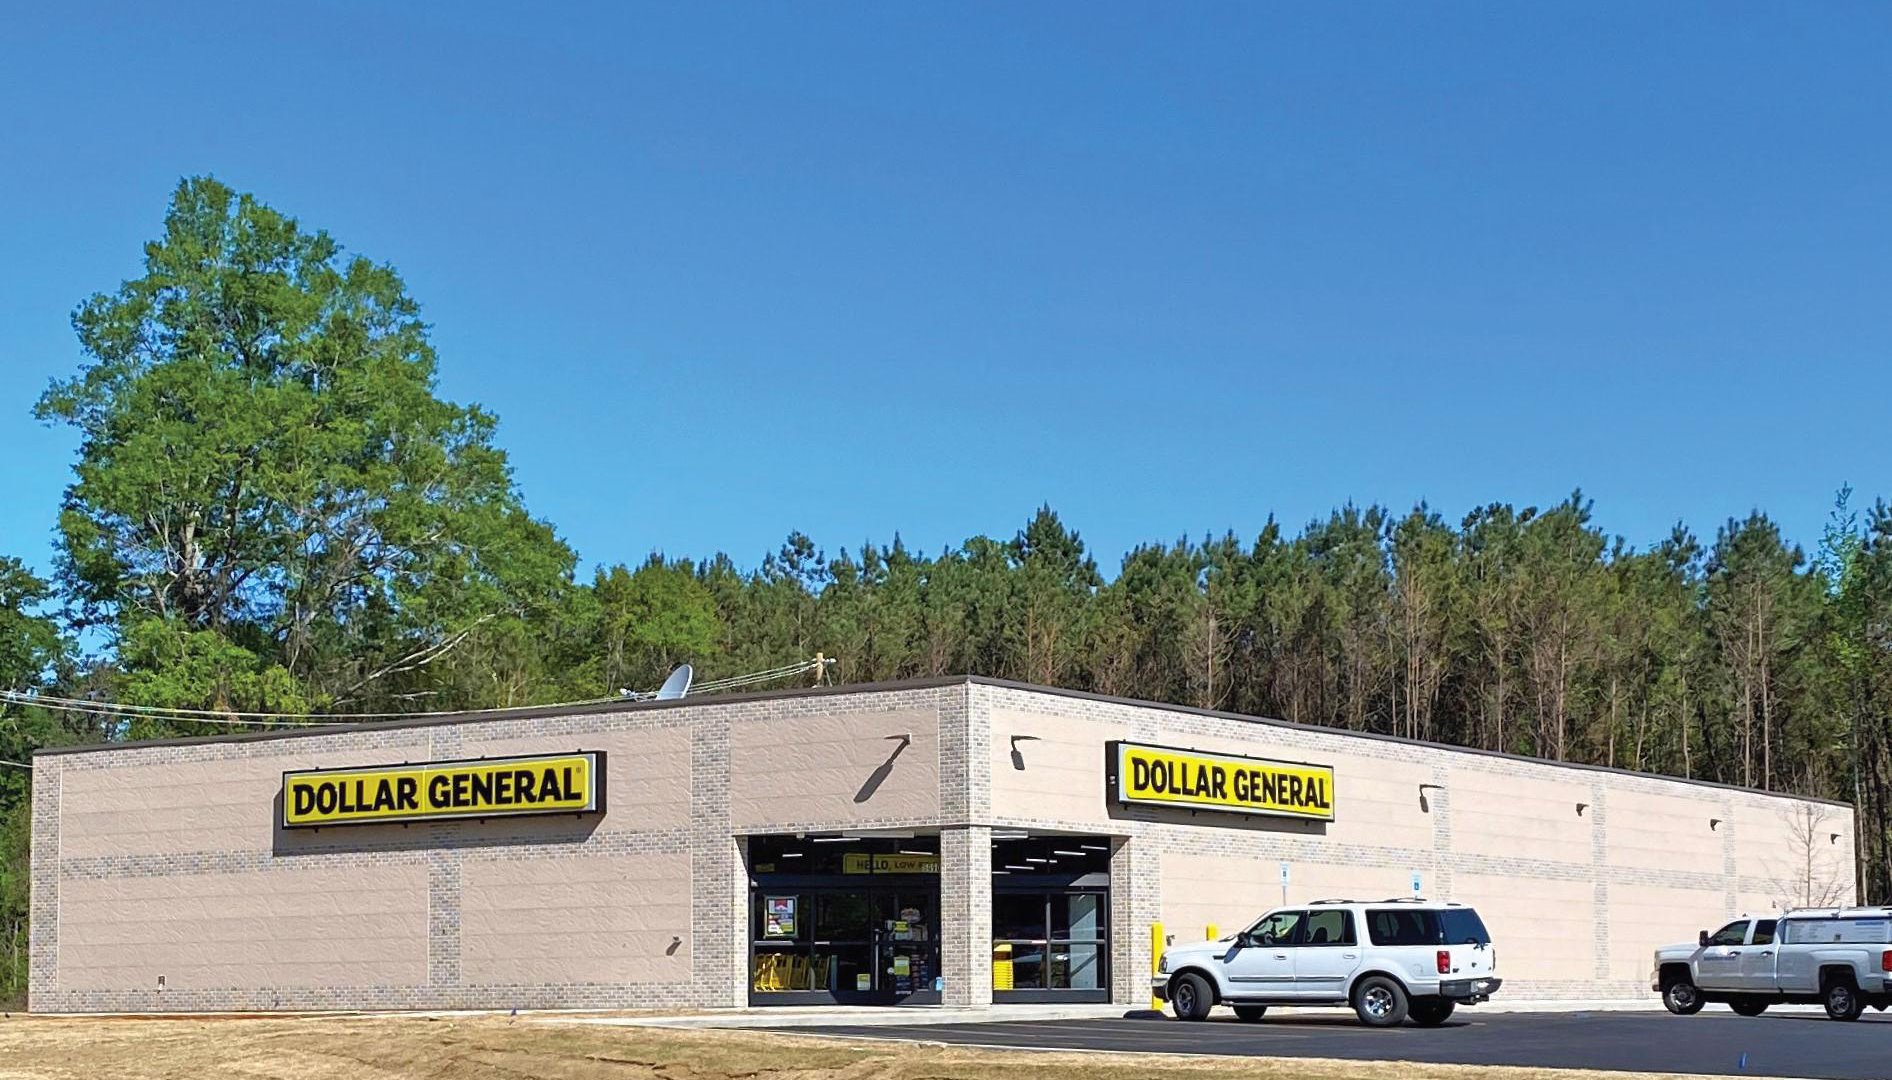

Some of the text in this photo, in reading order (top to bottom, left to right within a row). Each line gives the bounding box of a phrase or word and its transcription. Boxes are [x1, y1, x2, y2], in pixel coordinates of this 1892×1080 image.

[293, 767, 582, 816] DOLLAR GENERAL
[1131, 757, 1330, 809] DOLLAR GENERAL
